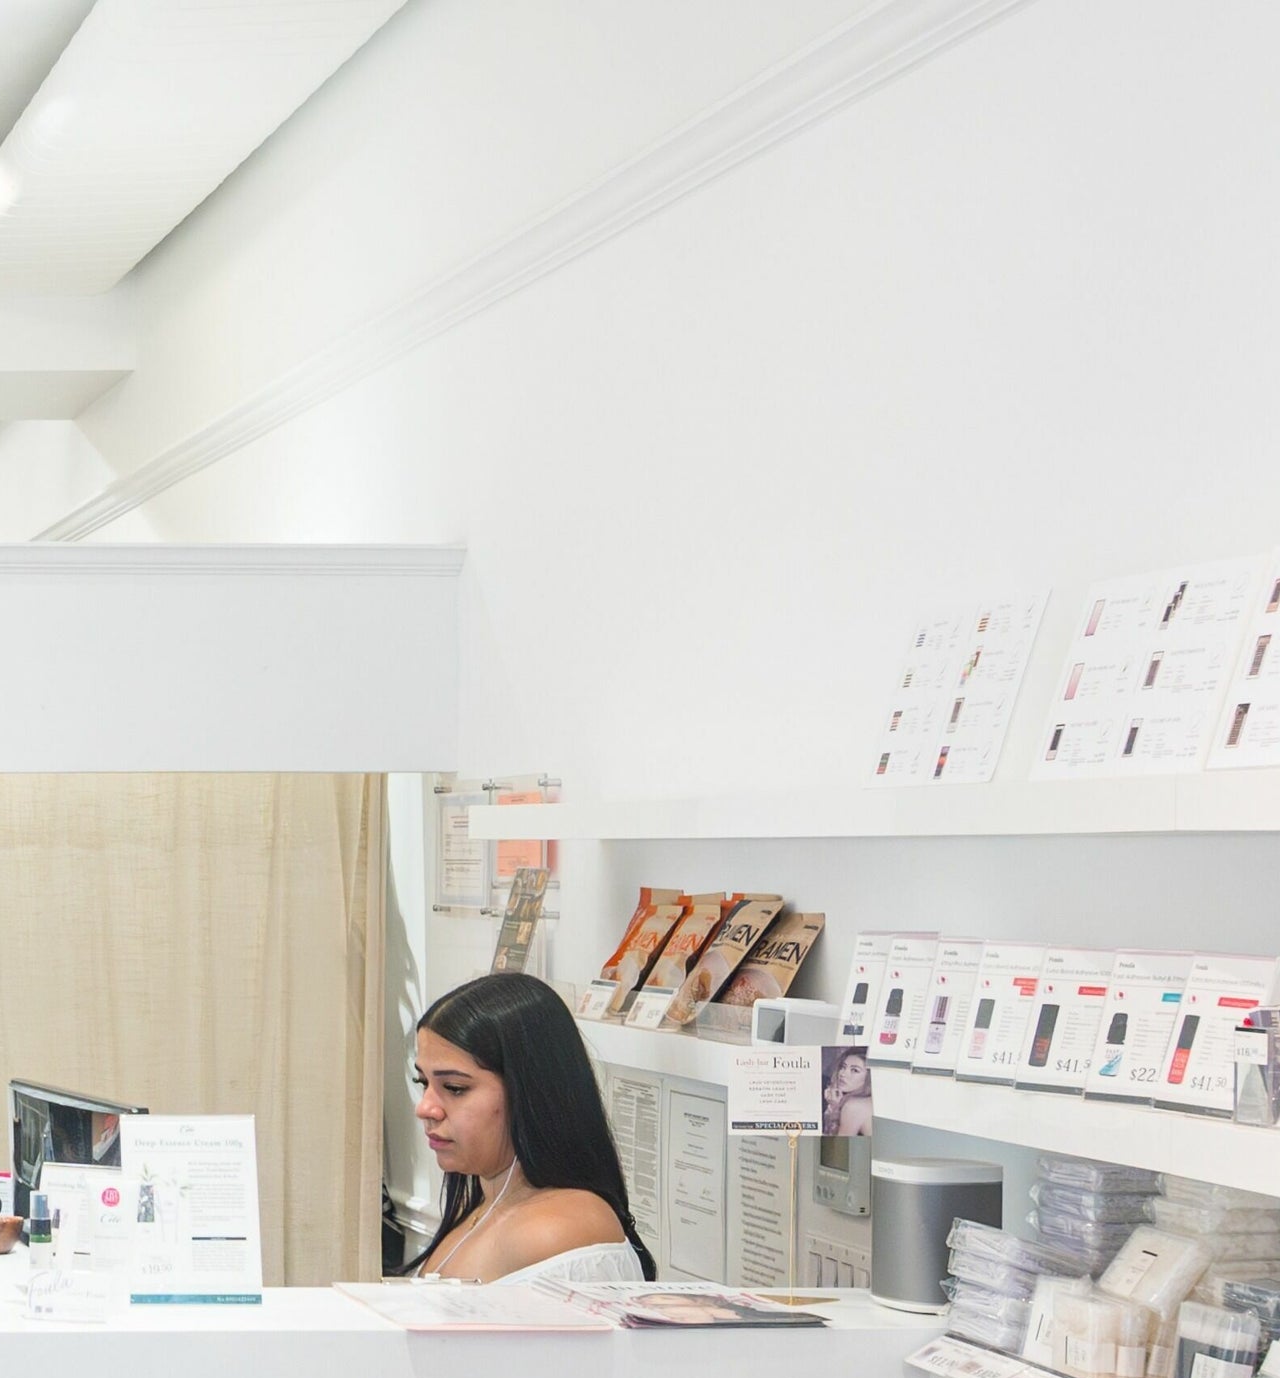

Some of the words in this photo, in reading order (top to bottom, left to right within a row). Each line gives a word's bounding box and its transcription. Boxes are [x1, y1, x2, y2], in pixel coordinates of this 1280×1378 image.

[756, 941, 808, 965] RAMEN
[736, 1058, 754, 1066] Lash
[773, 1056, 811, 1069] Foula
[1190, 1074, 1228, 1092] $41.50
[135, 1139, 157, 1148] Deep
[159, 1139, 191, 1147] Essence
[194, 1139, 221, 1147] Cream
